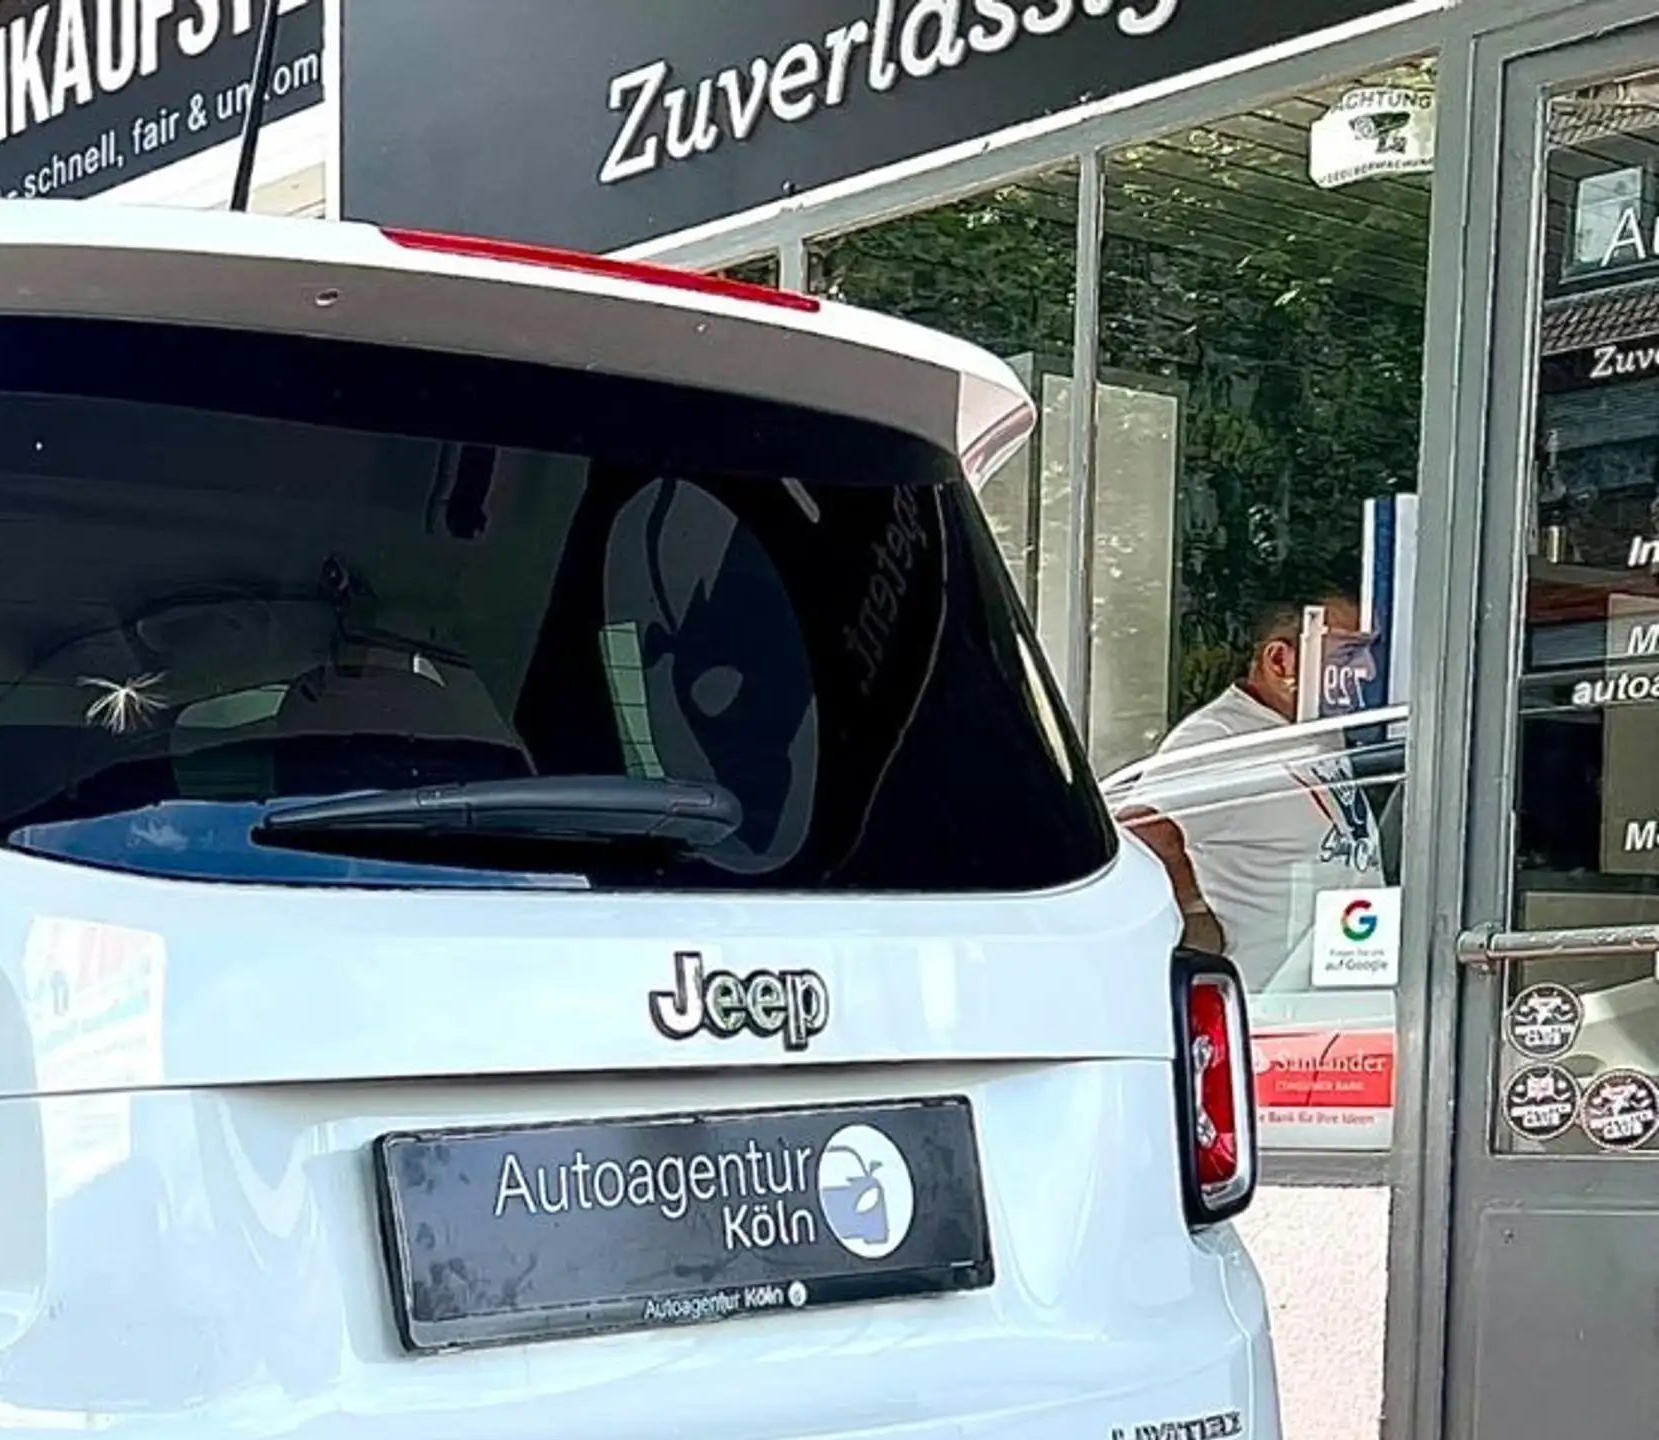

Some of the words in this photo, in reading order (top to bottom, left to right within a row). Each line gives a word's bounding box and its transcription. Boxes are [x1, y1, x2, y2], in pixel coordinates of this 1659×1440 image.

[24, 129, 124, 198] schnell,
[132, 108, 180, 154] fair
[188, 92, 208, 132] &
[216, 52, 319, 120] unom
[1331, 89, 1432, 115] ACHTUNG
[1600, 206, 1659, 267] A
[1624, 820, 1659, 851] M
[648, 950, 831, 1052] Jeep
[1275, 1049, 1387, 1073] Santander
[493, 1139, 812, 1219] Autoagentur
[722, 1198, 816, 1250] Köln
[643, 1291, 741, 1320] Autoagentur
[743, 1284, 784, 1309] Köln
